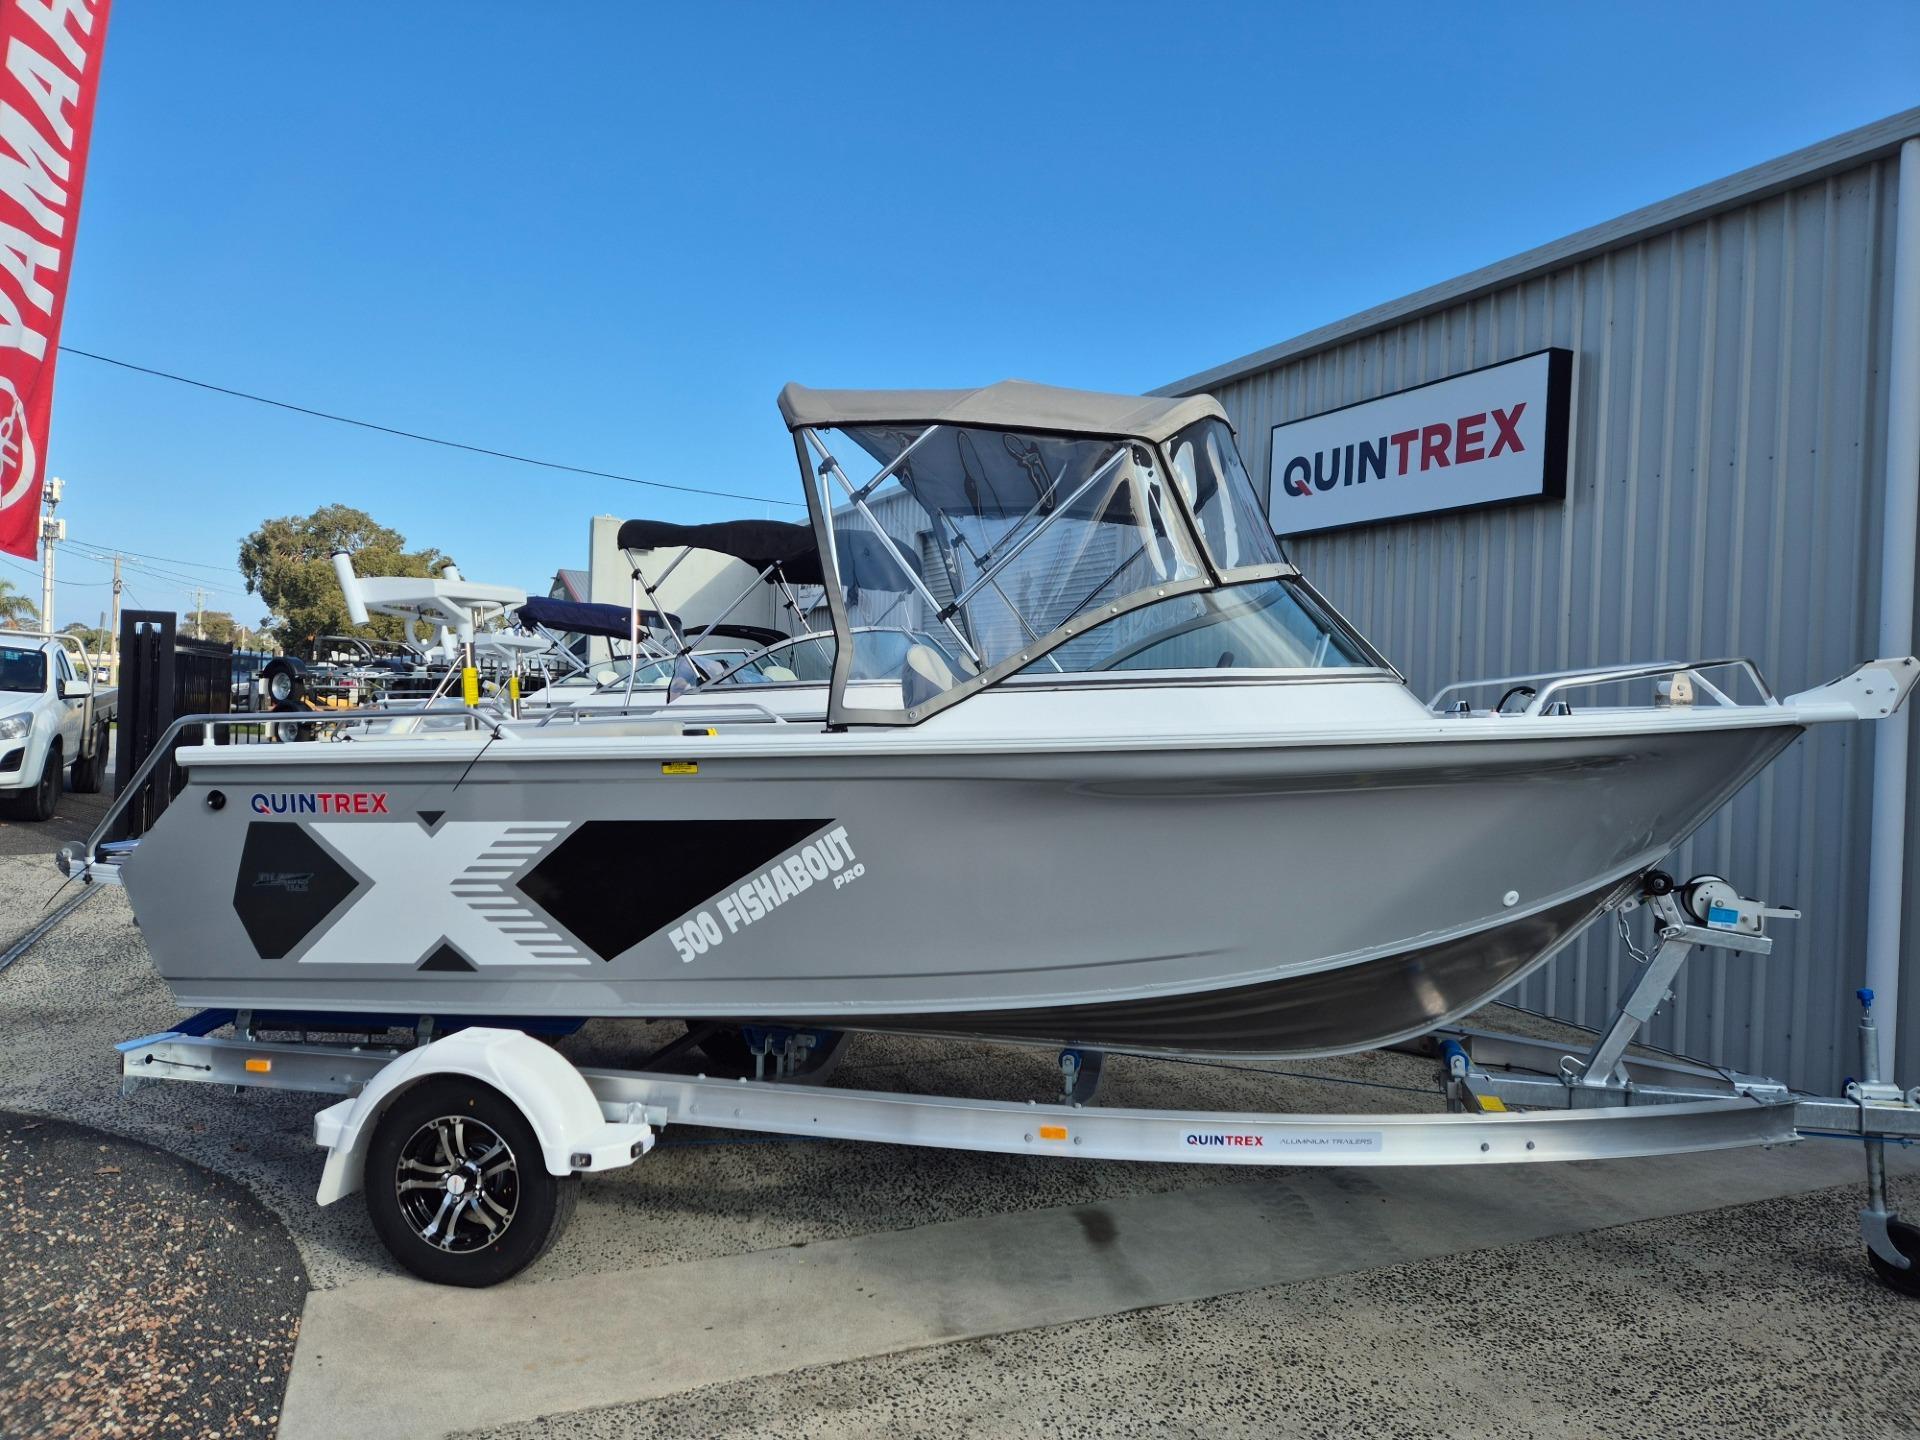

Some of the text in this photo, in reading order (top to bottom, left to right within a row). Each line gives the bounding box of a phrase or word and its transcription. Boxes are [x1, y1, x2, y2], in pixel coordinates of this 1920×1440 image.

[0, 0, 97, 363] YAMAH
[1283, 402, 1527, 497] QUINTREX
[251, 793, 388, 815] QUINTREX
[667, 825, 856, 963] 500 FISHABOUT
[832, 863, 866, 890] PRO
[1186, 1134, 1264, 1147] QUINTREX
[1331, 1138, 1373, 1146] TRAILERS
